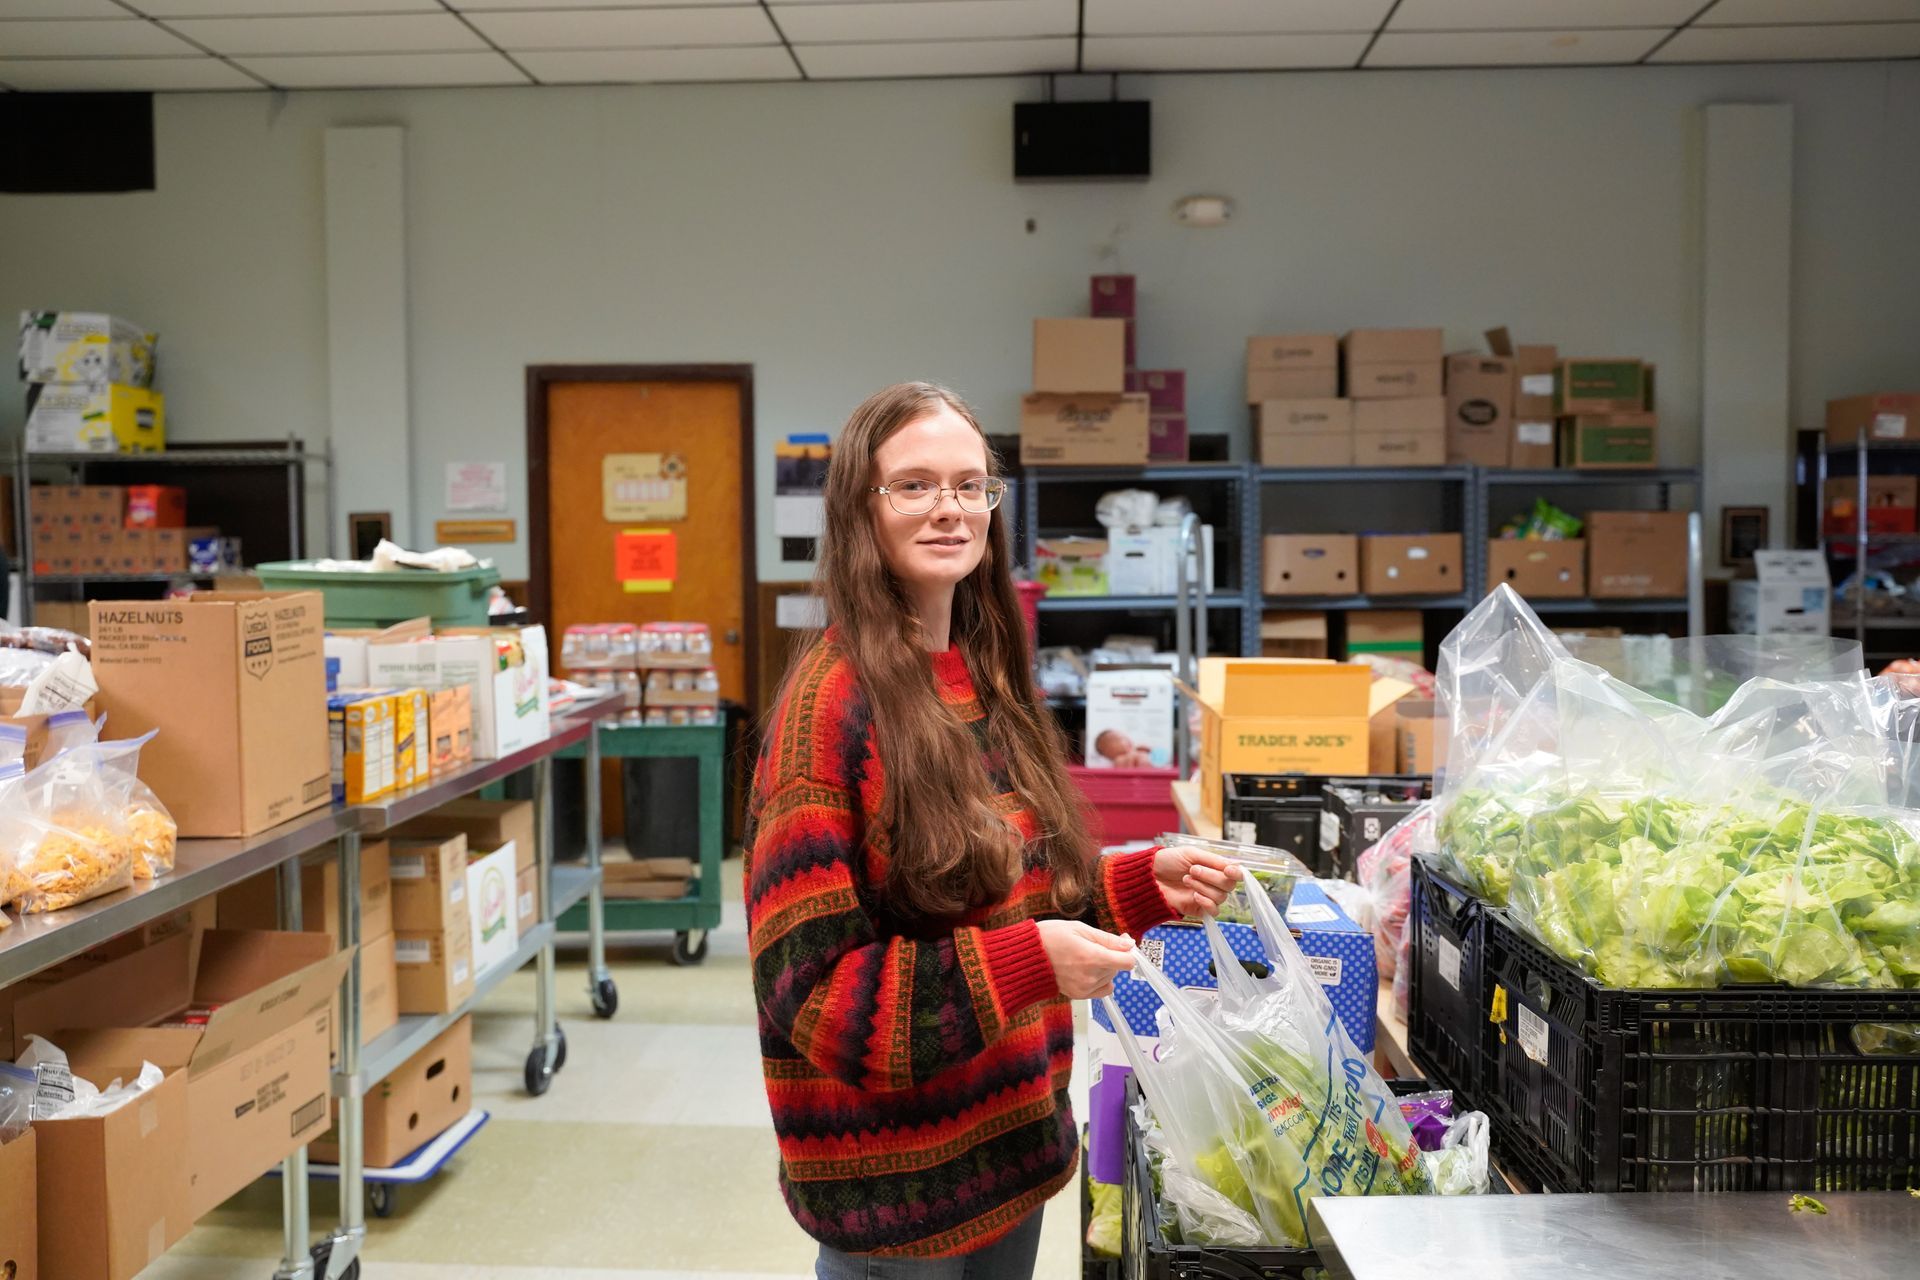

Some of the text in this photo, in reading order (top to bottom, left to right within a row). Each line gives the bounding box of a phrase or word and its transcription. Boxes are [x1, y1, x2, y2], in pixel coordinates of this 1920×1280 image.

[98, 611, 184, 625] HAZELNUTS
[1238, 735, 1298, 748] TRADER
[1341, 1058, 1367, 1121] FOOD
[1328, 1100, 1342, 1125] IT'S
[1343, 1115, 1359, 1143] THAN
[1353, 1145, 1375, 1192] IT'S MY
